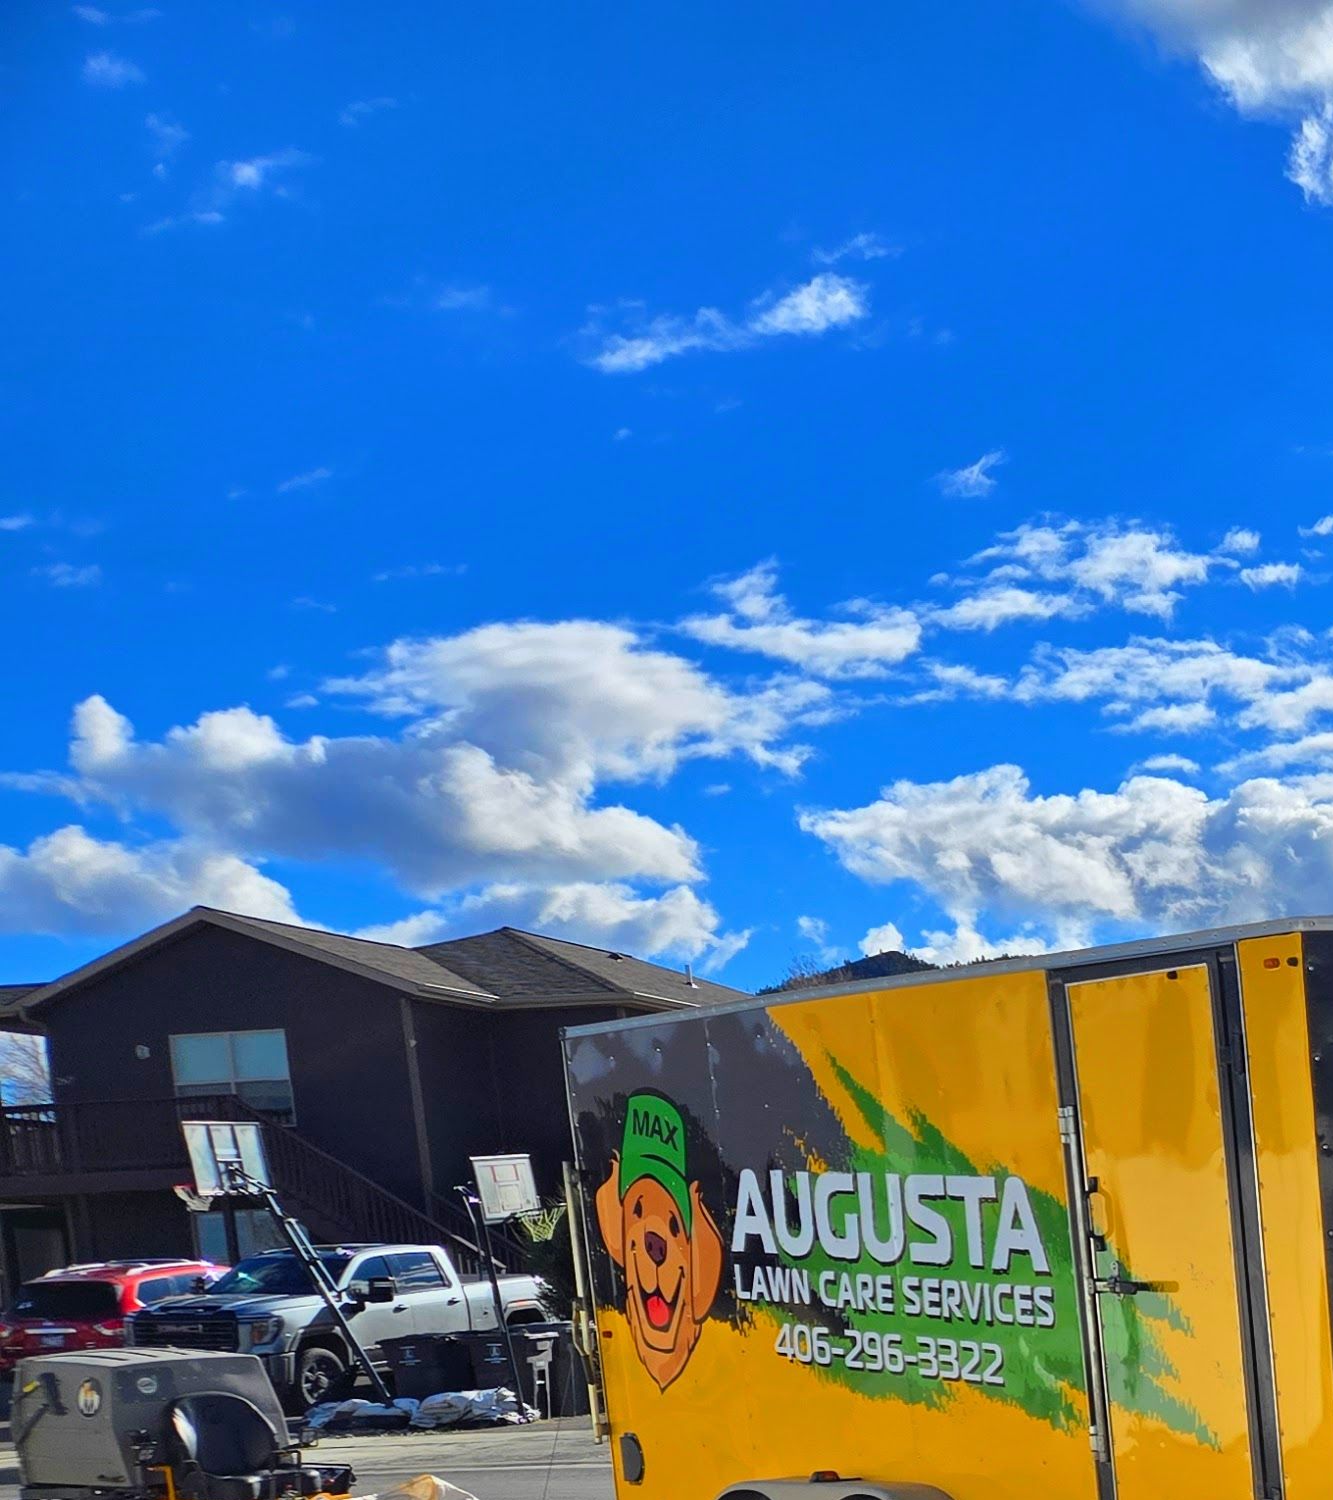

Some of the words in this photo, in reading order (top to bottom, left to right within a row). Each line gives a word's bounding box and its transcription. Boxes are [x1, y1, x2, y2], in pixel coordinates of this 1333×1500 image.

[632, 1108, 679, 1152] MAX
[731, 1168, 1053, 1276] AUGUSTA
[733, 1263, 811, 1307] LAWN
[818, 1269, 895, 1314] CARE
[902, 1276, 1057, 1328] SERVICES
[774, 1322, 1006, 1385] 406-296-3322
